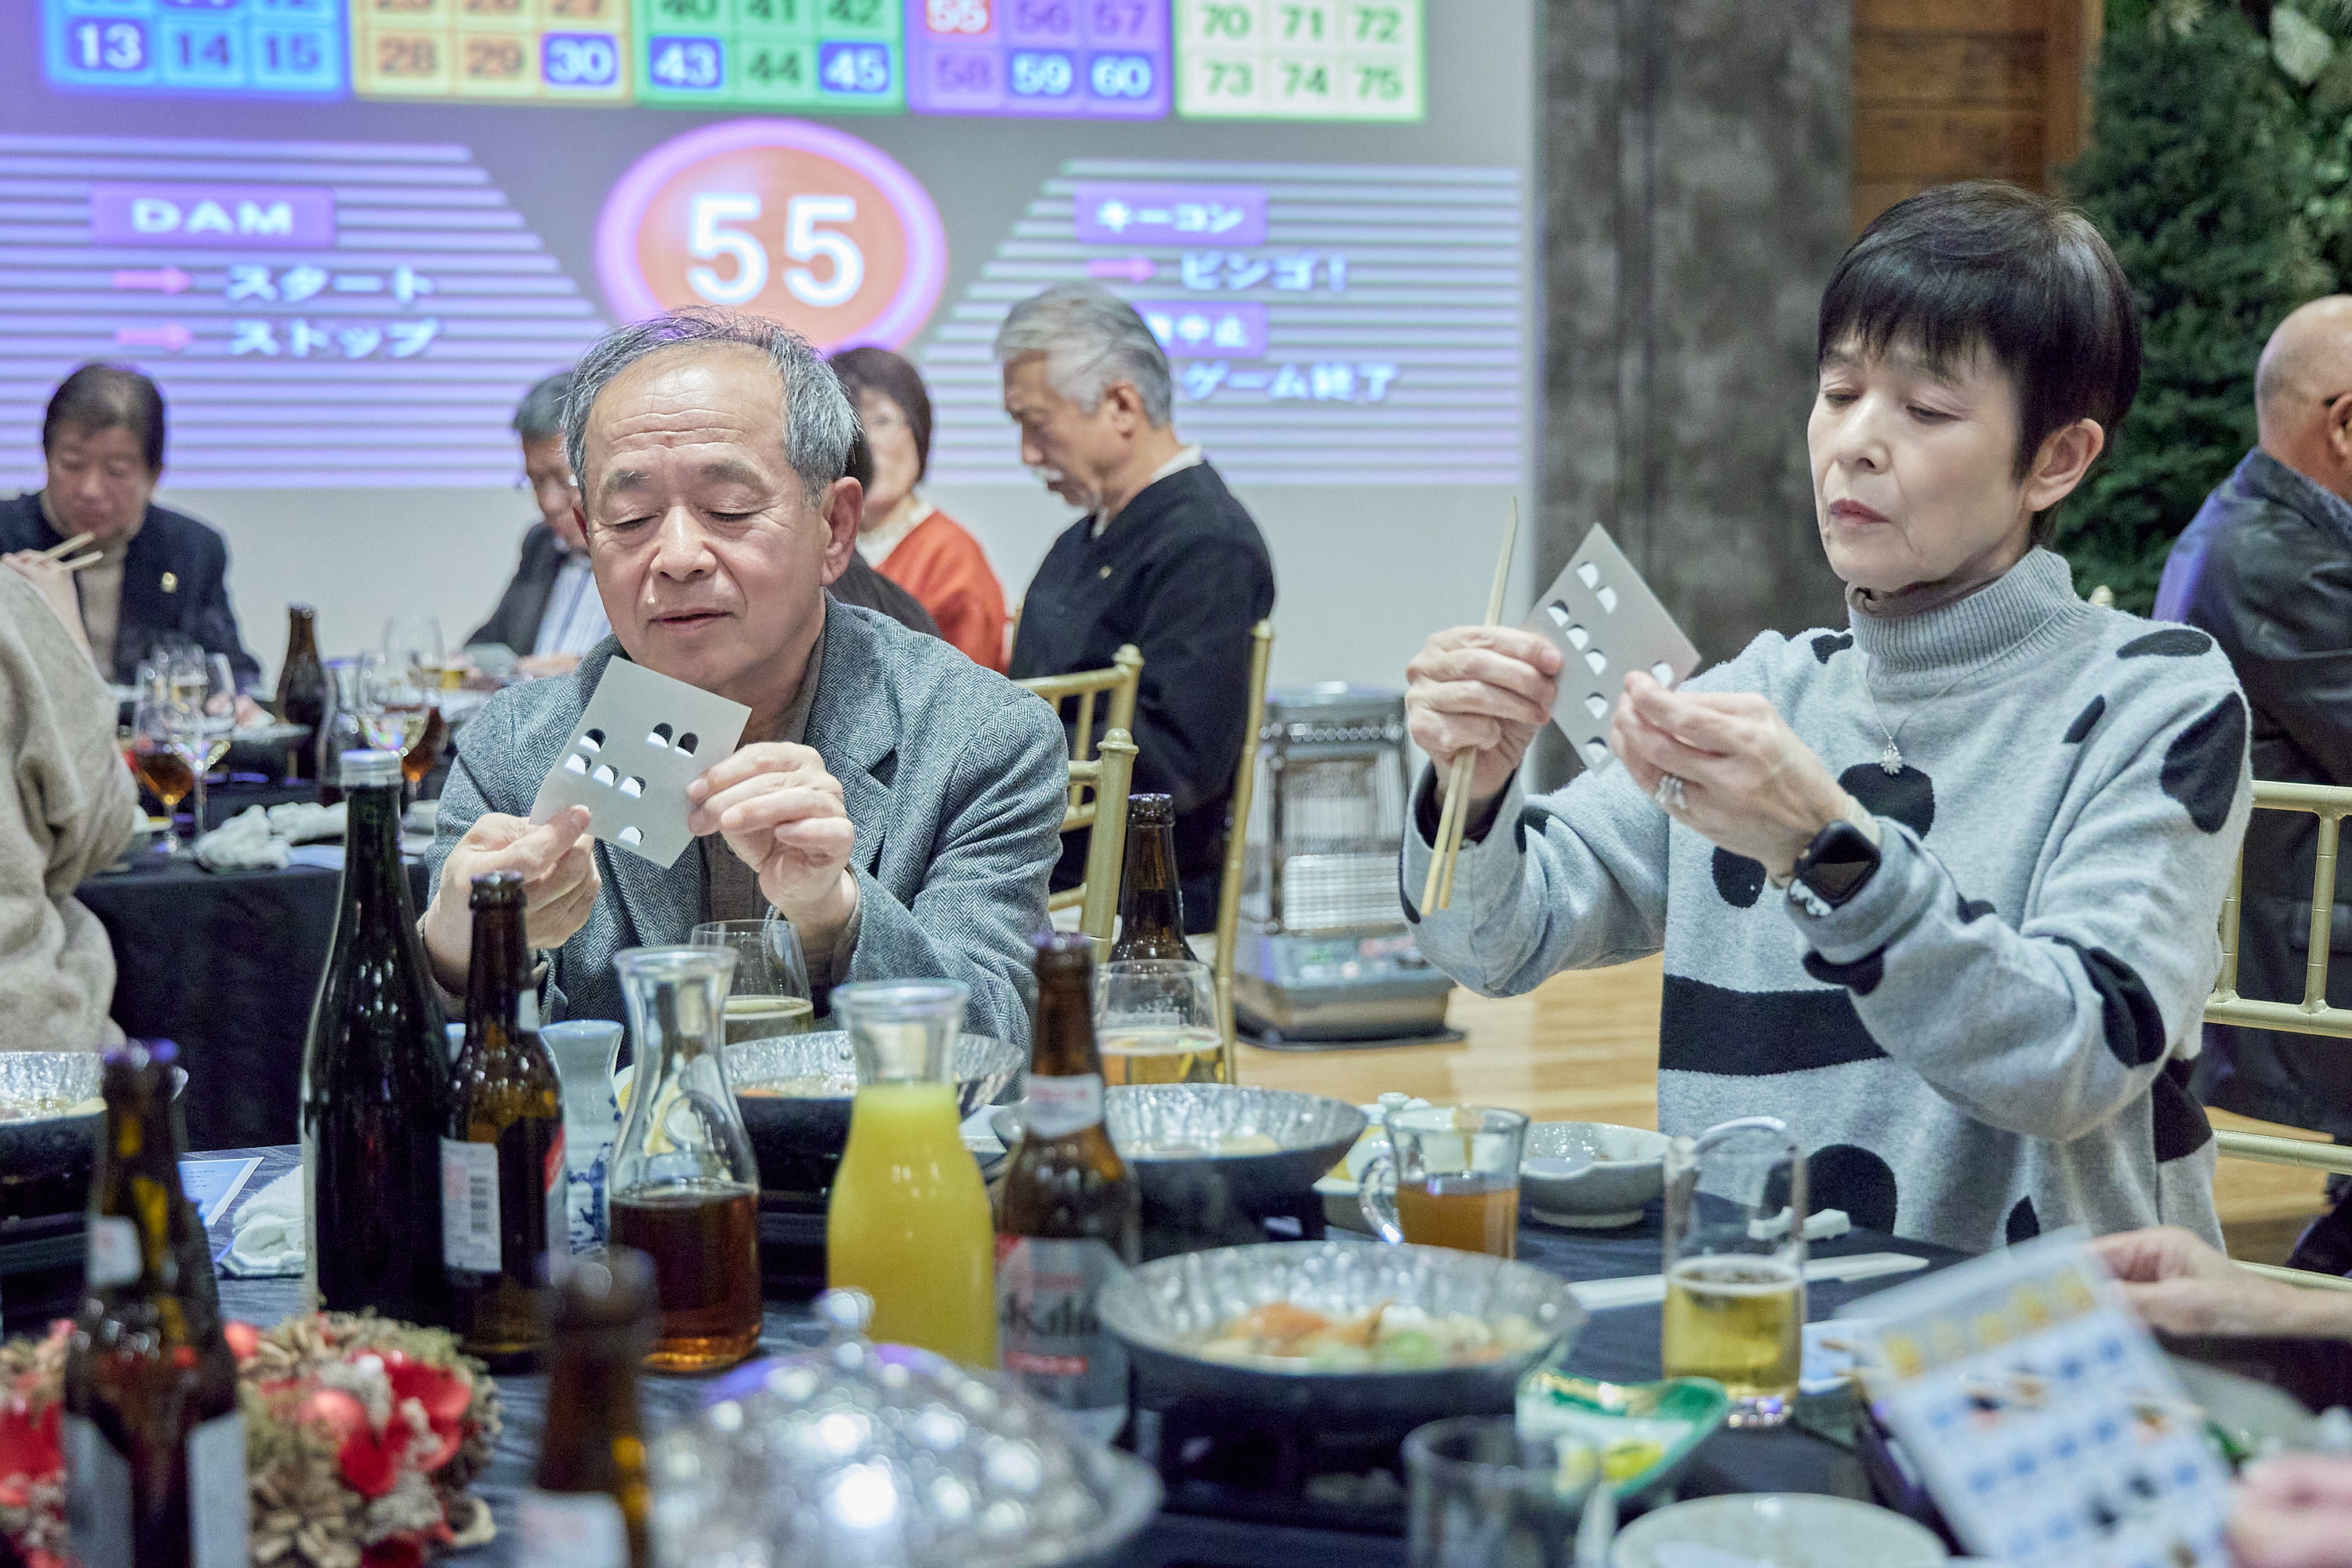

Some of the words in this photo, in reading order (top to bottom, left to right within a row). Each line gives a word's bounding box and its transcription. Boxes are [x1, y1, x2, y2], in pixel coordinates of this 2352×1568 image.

[1202, 5, 1251, 38] 70
[1278, 6, 1323, 39] 71
[1353, 7, 1403, 42] 72
[79, 23, 142, 68] 13
[177, 33, 227, 65] 14
[267, 34, 319, 69] 15
[550, 38, 613, 81] 30
[654, 42, 717, 84] 43
[749, 49, 800, 86] 44
[827, 47, 888, 90] 45
[1012, 53, 1073, 95] 59
[1091, 55, 1150, 96] 60
[1203, 61, 1252, 96] 73
[1282, 63, 1328, 97] 74
[1355, 64, 1404, 100] 75
[131, 198, 292, 234] DAM
[687, 192, 864, 306] 55
[227, 264, 434, 303] スタート
[229, 317, 441, 358] ストップ
